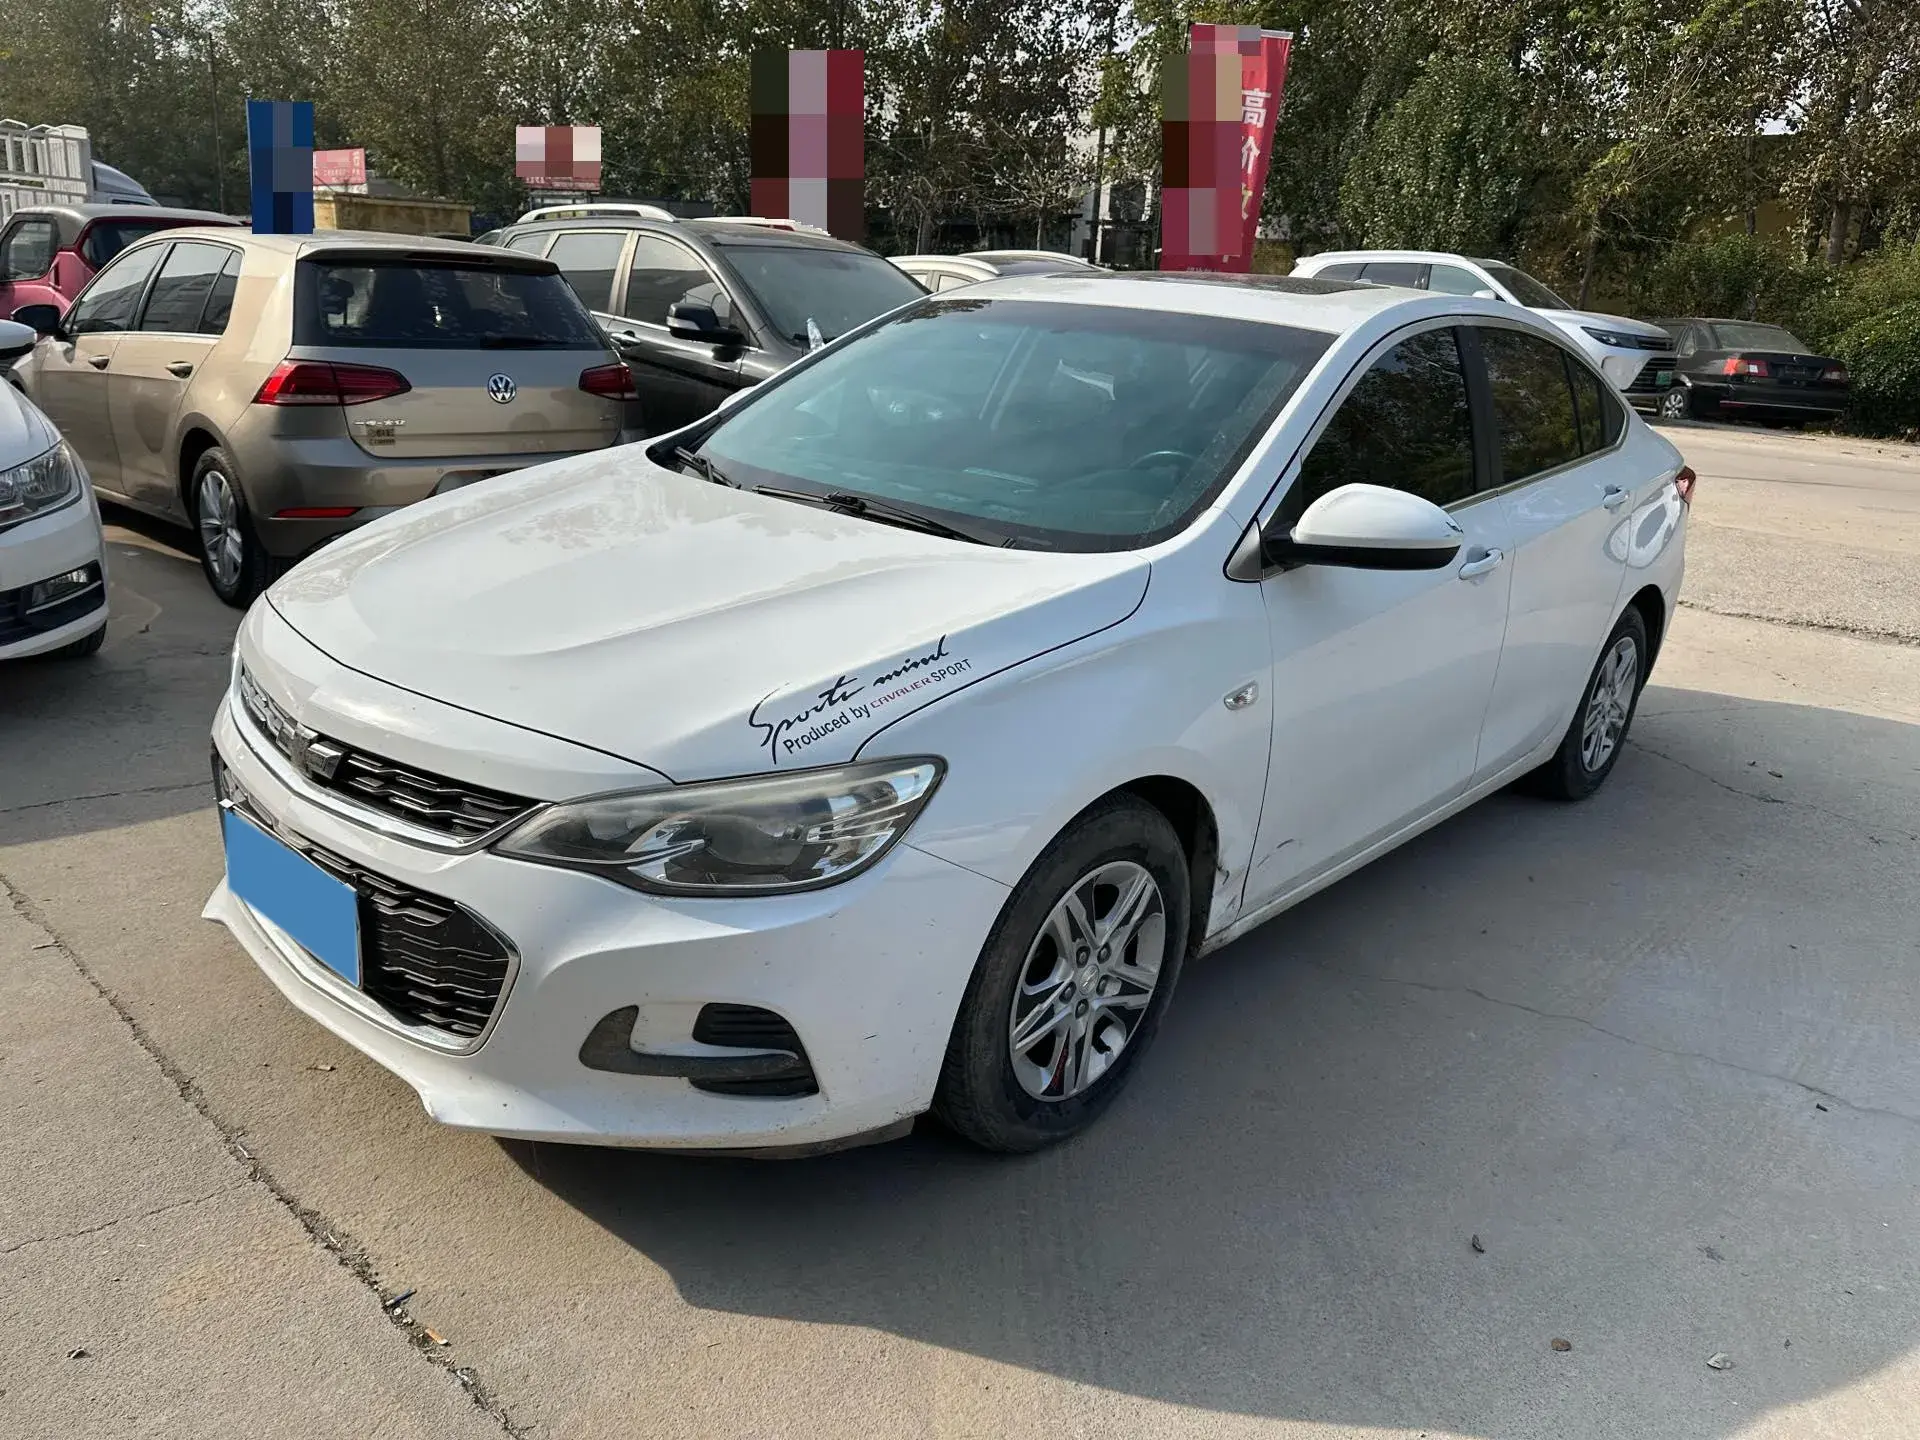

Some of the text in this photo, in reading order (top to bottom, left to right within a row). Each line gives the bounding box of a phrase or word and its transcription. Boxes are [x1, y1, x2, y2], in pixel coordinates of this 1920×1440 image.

[872, 634, 949, 687] mind
[782, 658, 972, 755] Produced by CAVALIER SPORT
